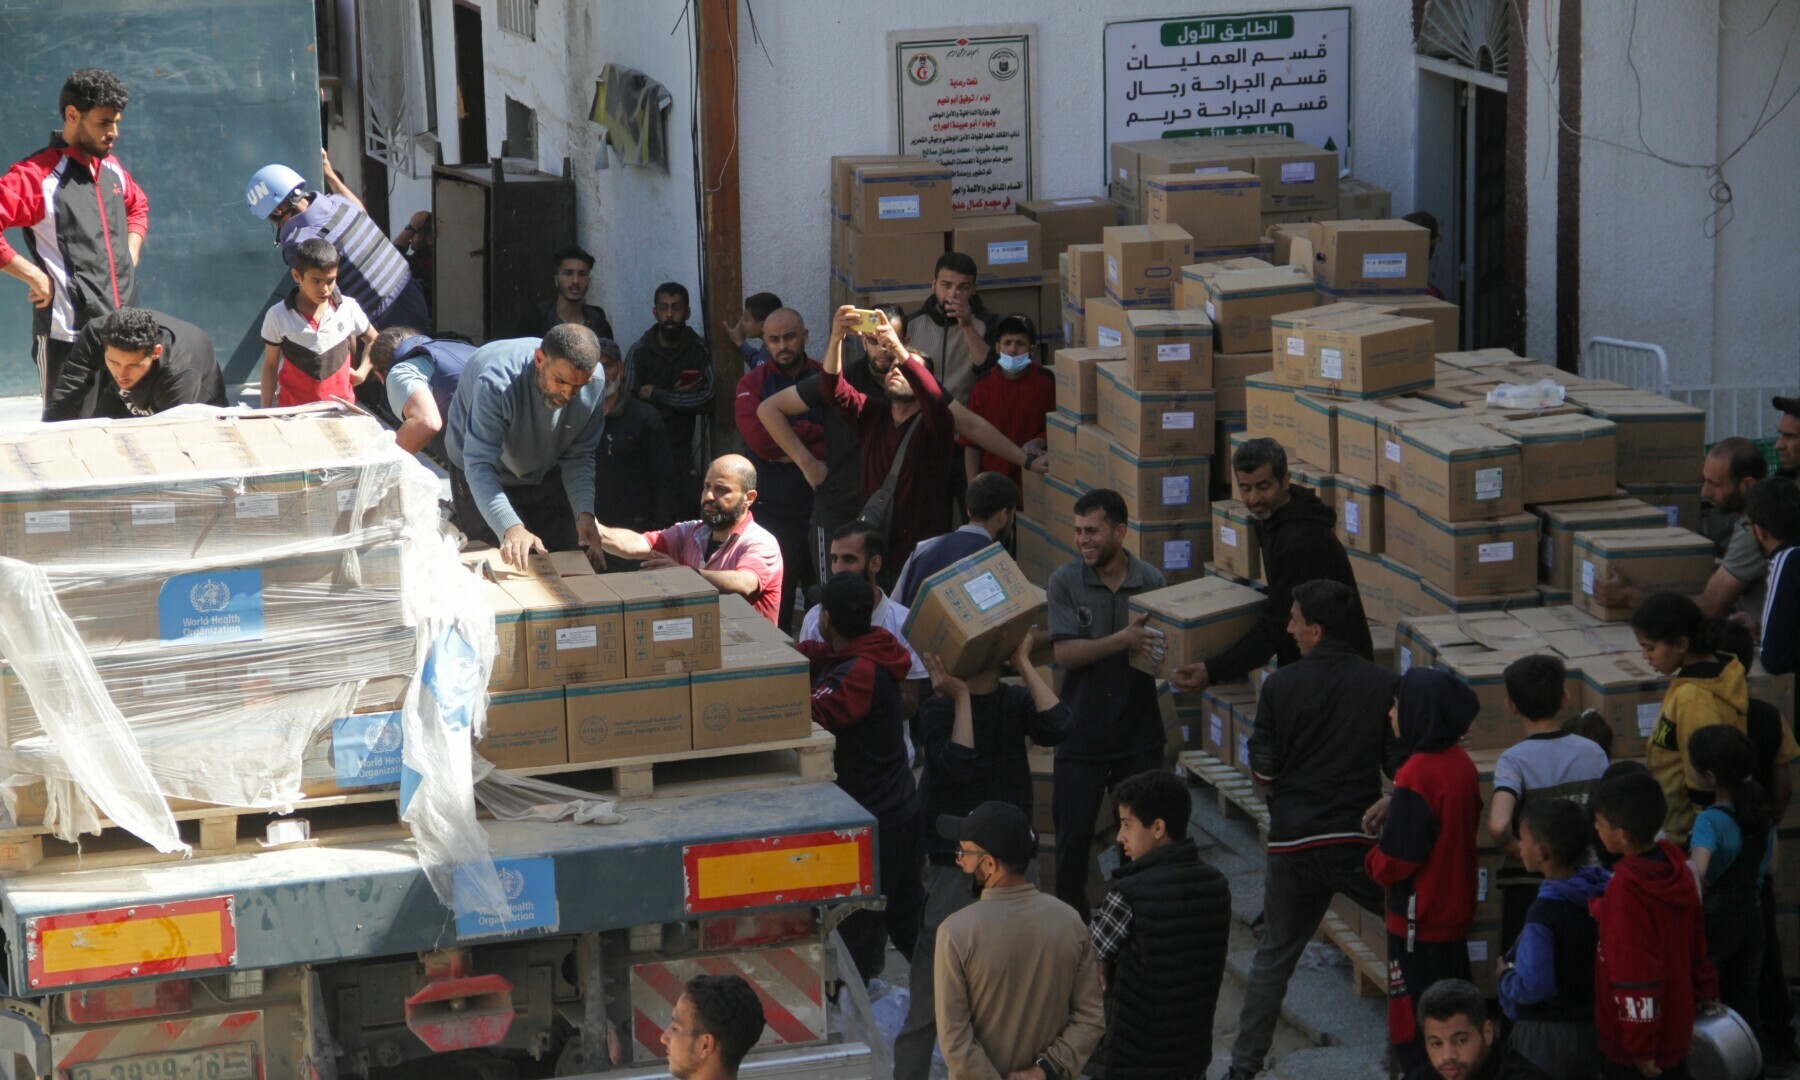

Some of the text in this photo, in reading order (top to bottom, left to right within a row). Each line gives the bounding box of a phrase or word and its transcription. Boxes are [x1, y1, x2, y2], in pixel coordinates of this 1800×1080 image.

[1177, 19, 1278, 45] الطابق الأول
[1126, 43, 1328, 72] قسم العمليات
[949, 78, 966, 89] رعاية
[1126, 69, 1328, 101] قسم الجراحة رجال
[1126, 96, 1328, 127] قسم الجراحة حريم
[247, 180, 270, 205] UN
[967, 198, 984, 210] كمال
[1002, 195, 1011, 210] في
[182, 613, 241, 627] World Health
[182, 623, 241, 639] Organization
[359, 756, 402, 768] World Hea
[358, 764, 402, 779] Organizati
